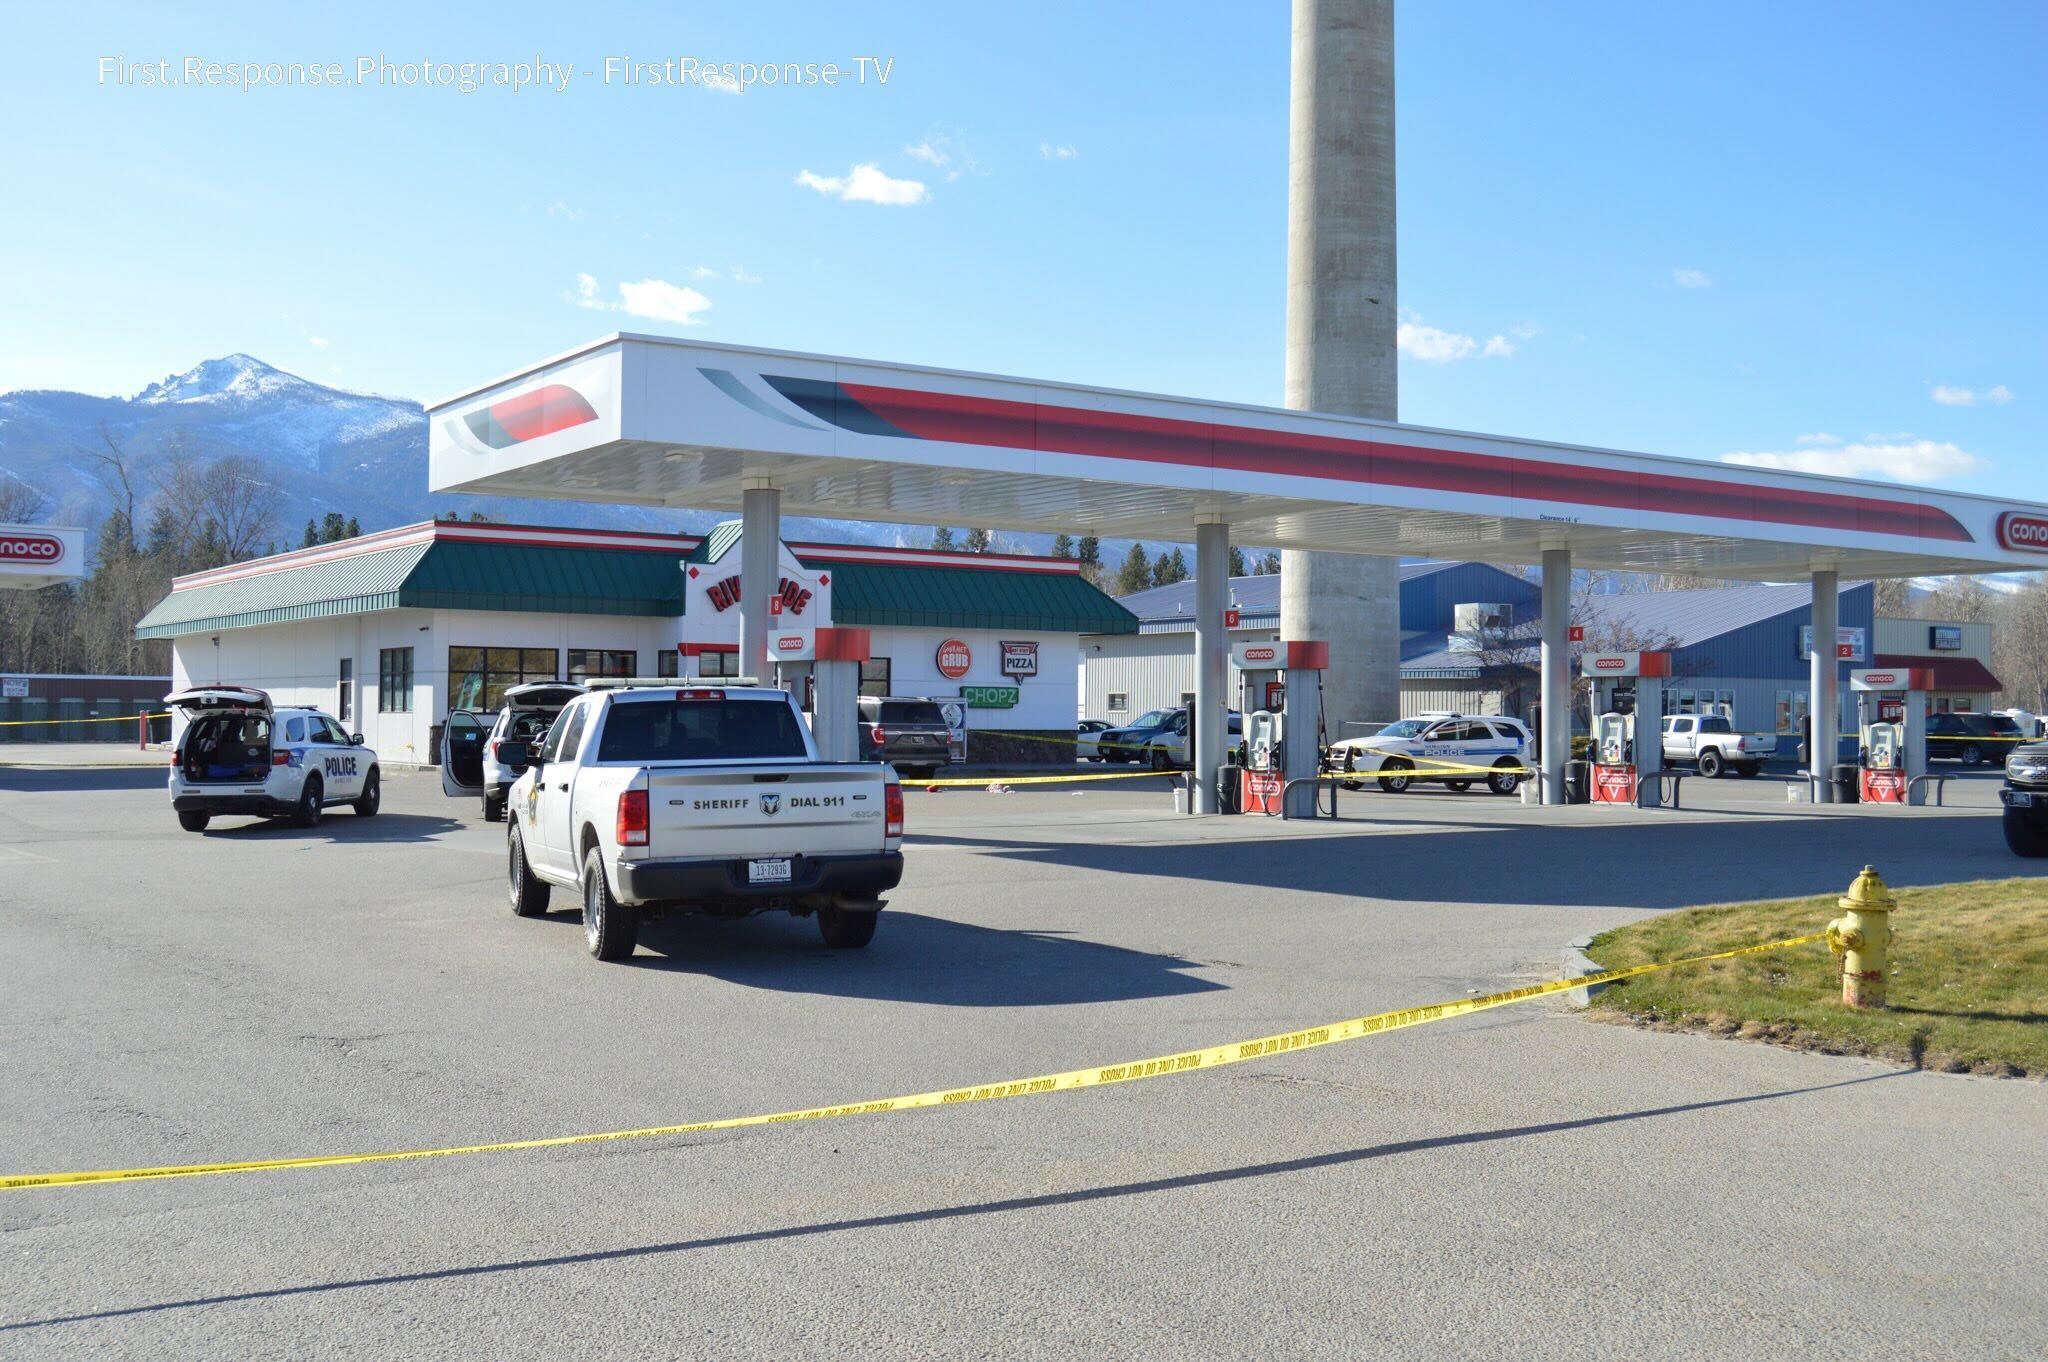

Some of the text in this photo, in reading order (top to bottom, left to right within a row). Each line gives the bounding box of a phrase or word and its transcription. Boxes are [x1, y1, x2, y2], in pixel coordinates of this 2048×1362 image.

[774, 600, 779, 611] 8
[1230, 614, 1234, 623] 6
[780, 640, 802, 648] conoco
[943, 654, 968, 667] GRUB
[1246, 650, 1274, 658] conoco
[1006, 658, 1033, 668] PIZZA
[964, 688, 1017, 703] CHOPZ
[325, 757, 358, 777] POLICE
[694, 796, 846, 810] SHERIFF DIAL 911
[1363, 1005, 1442, 1032] POLICE LINE DO NOT CROSS
[1240, 1029, 1330, 1058] POLICE LINE DO NOT CROSS
[1098, 1054, 1202, 1082] POLICE LINE DO NOT CROSS
